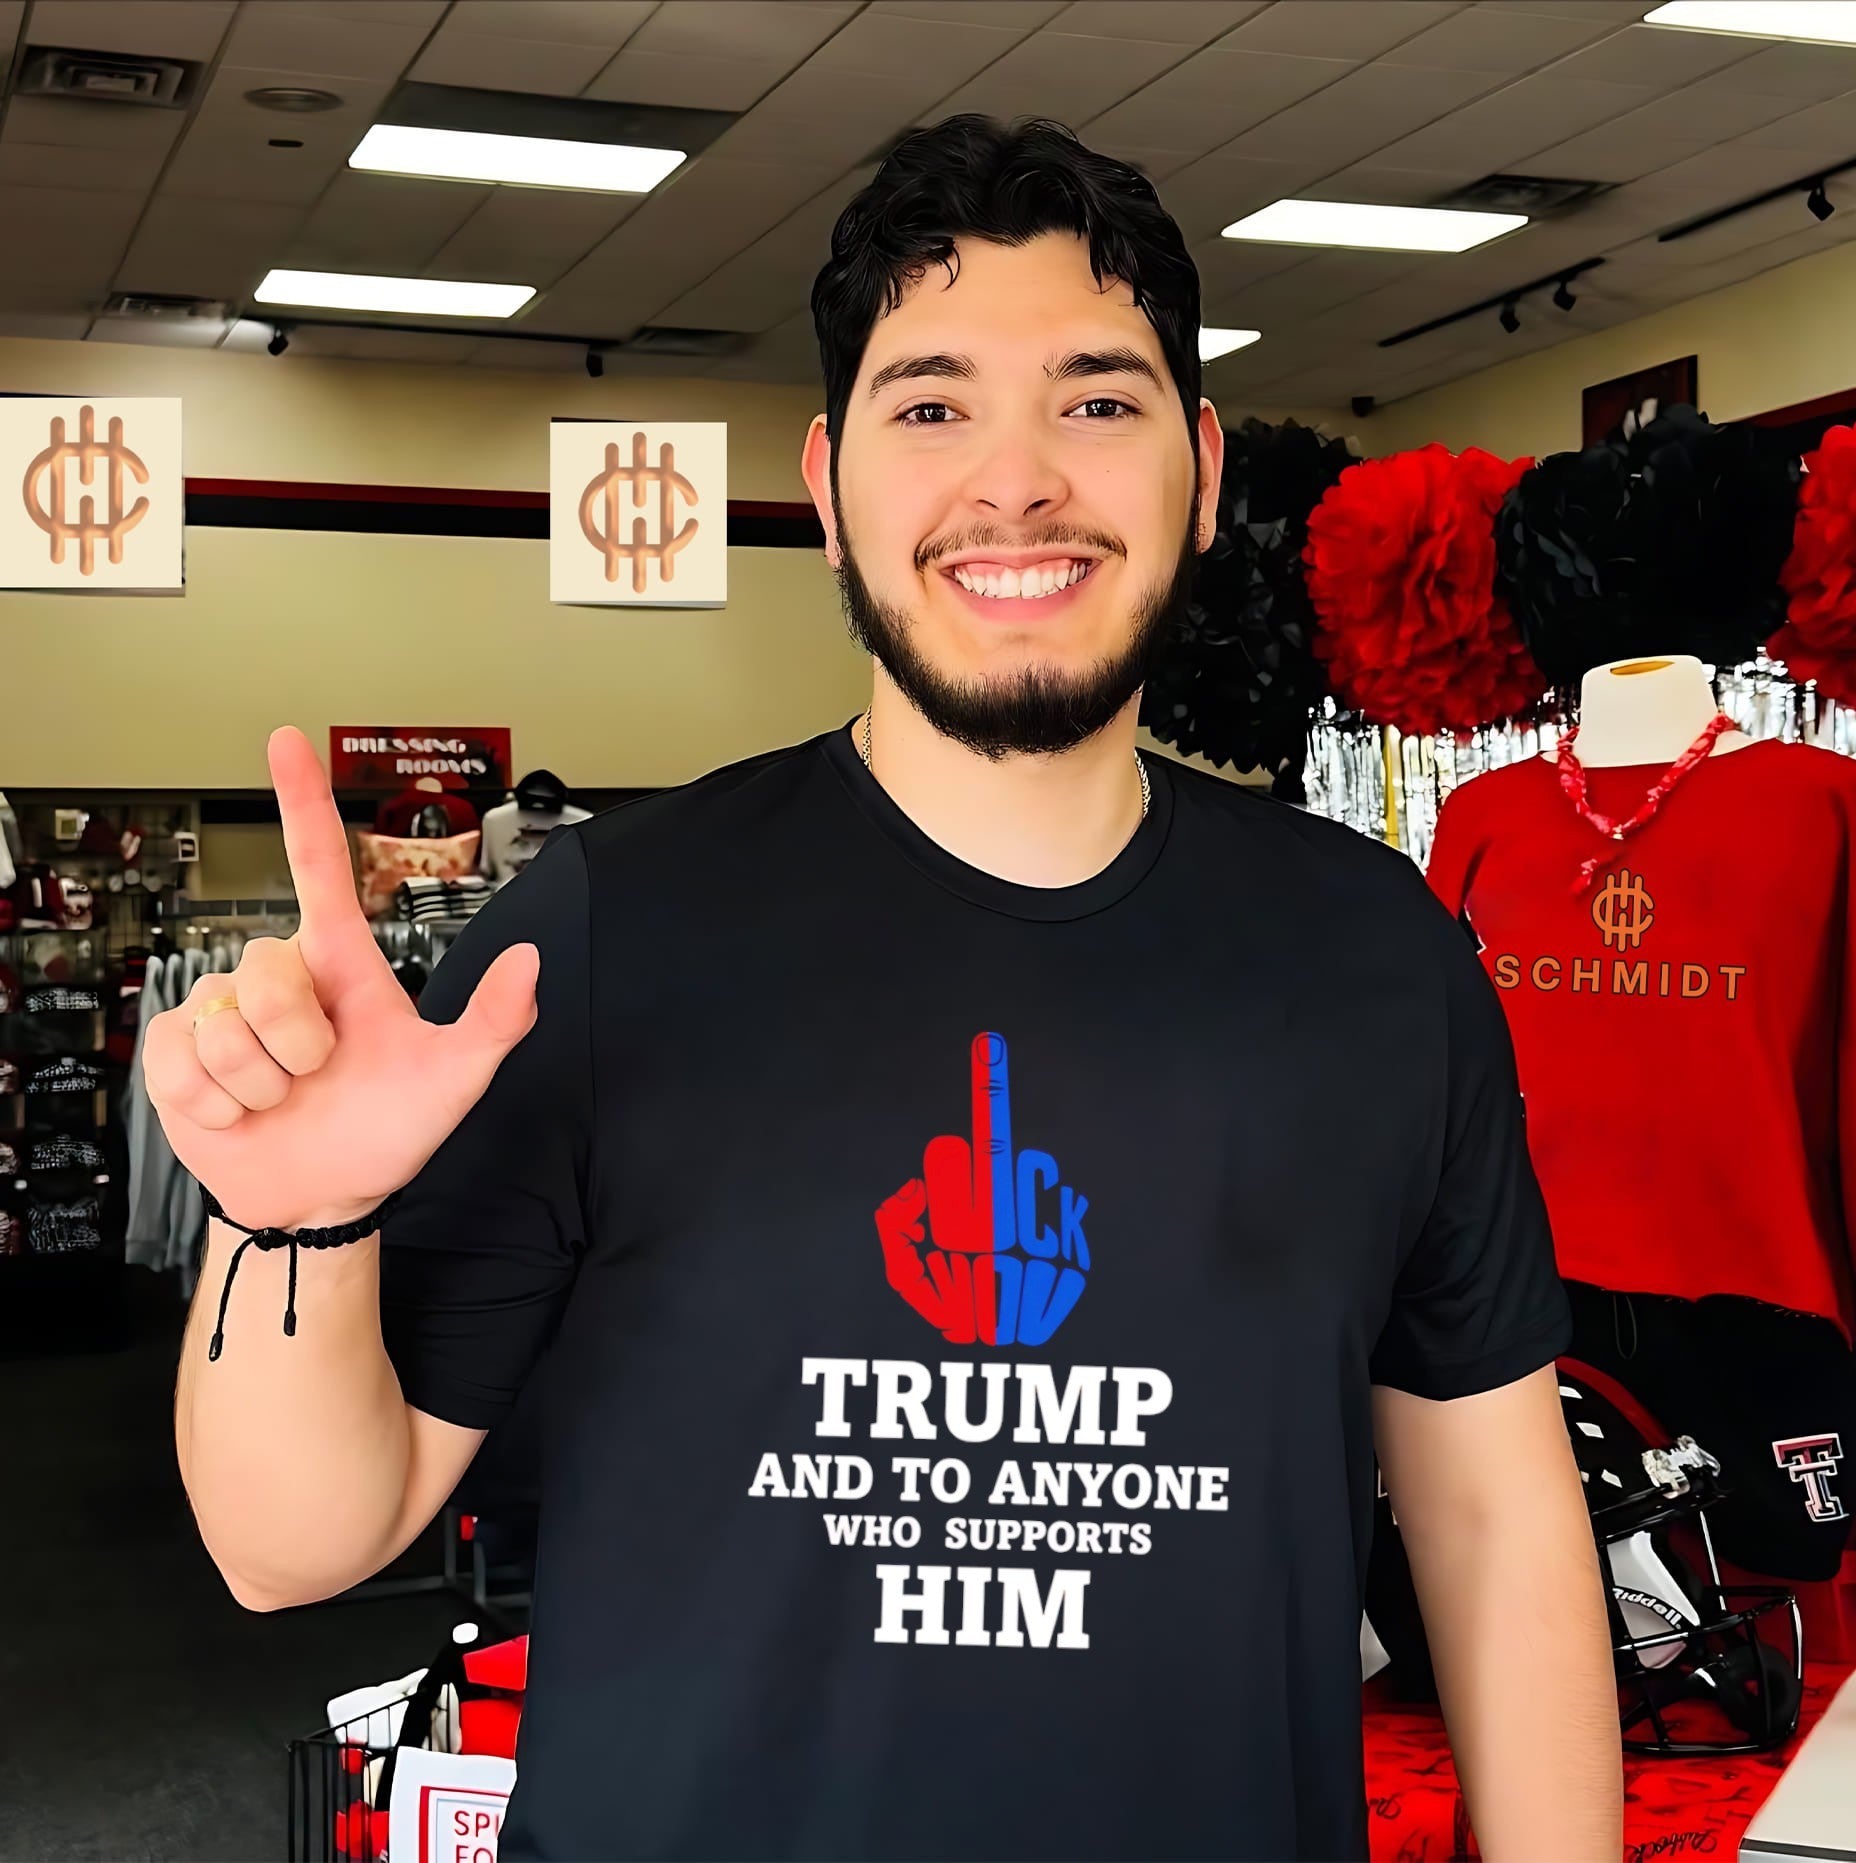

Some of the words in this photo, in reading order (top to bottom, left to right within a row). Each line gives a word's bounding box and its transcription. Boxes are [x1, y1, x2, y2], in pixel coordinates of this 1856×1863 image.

[342, 737, 467, 754] DRESSING
[396, 758, 487, 775] ROOMS
[1494, 954, 1746, 999] SCHMIDT
[801, 1357, 1173, 1447] TRUMP
[747, 1452, 874, 1500] AND
[891, 1456, 972, 1504] TO
[987, 1459, 1230, 1512] ANYONE
[822, 1513, 922, 1549] WHO
[944, 1517, 1153, 1556] SUPPORTS
[873, 1563, 1092, 1650] HIM
